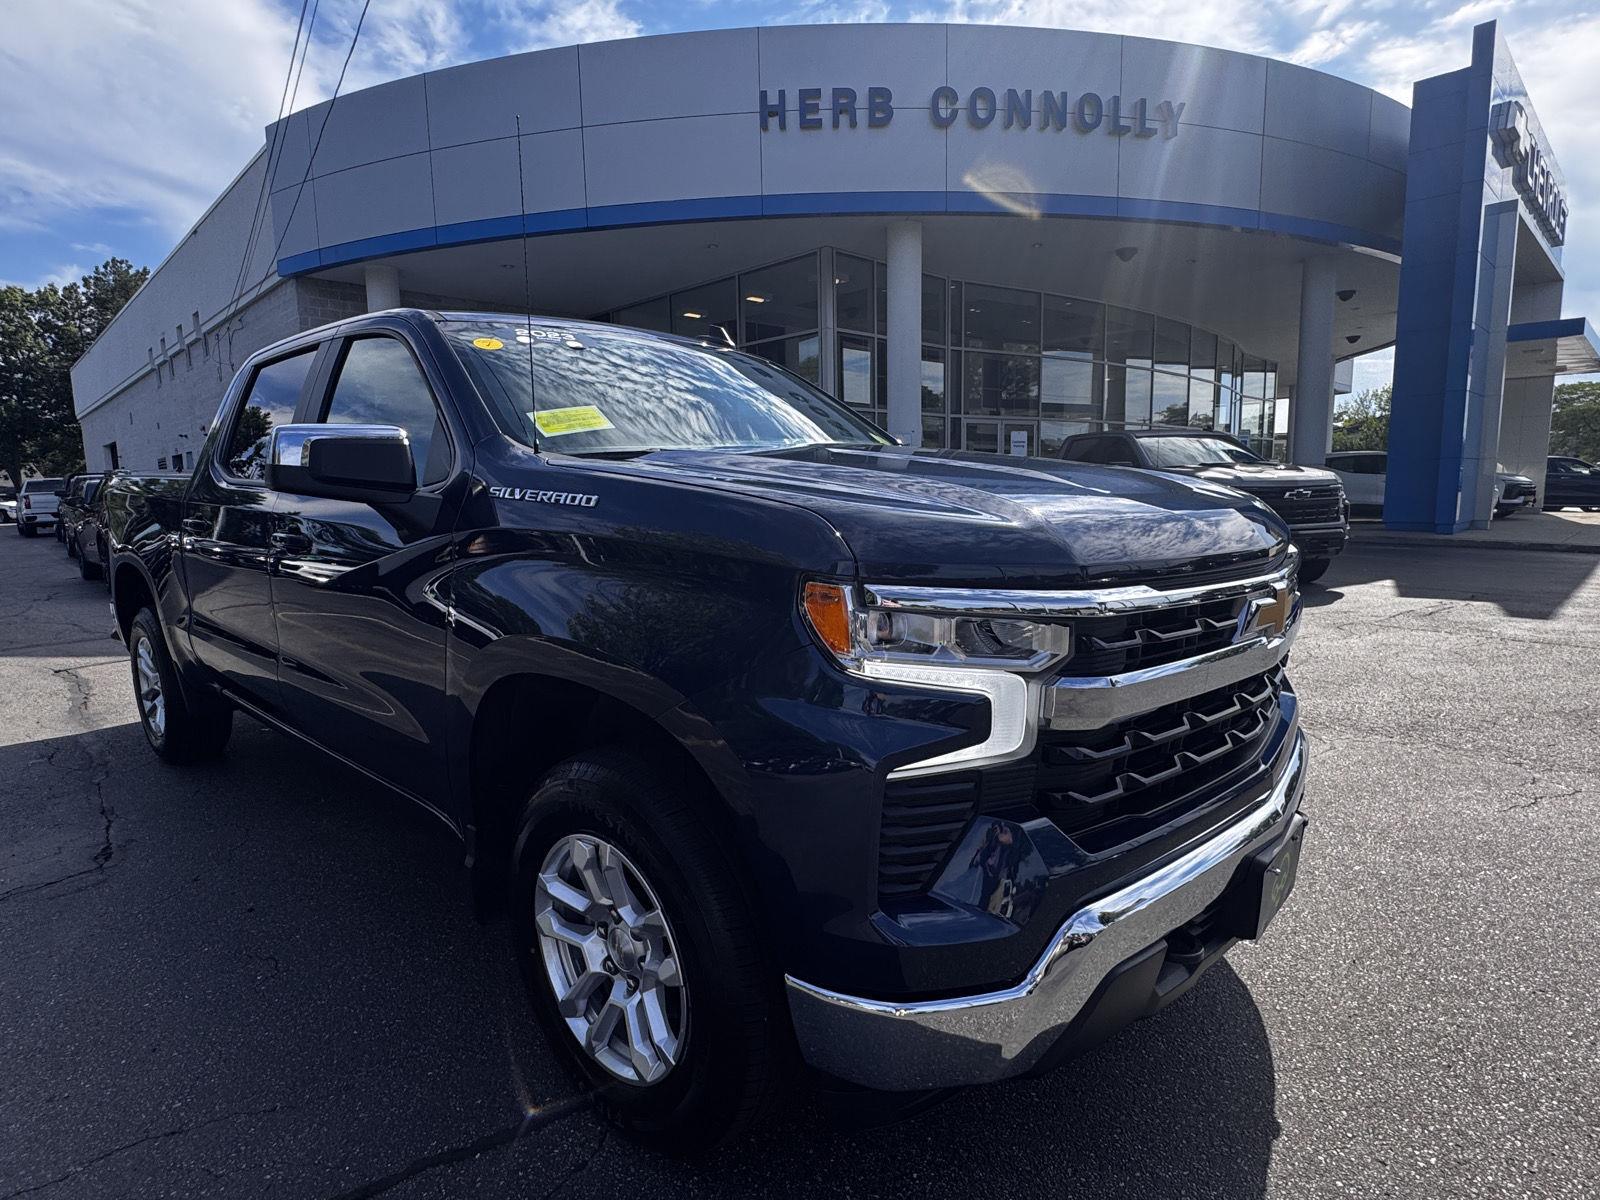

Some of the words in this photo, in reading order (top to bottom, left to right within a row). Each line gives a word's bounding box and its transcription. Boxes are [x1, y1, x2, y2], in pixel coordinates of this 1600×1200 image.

[759, 87, 894, 131] HERB
[930, 86, 1186, 139] CONNOLLY
[1516, 132, 1570, 246] CHEVROLE
[490, 486, 599, 507] SILVERADO
